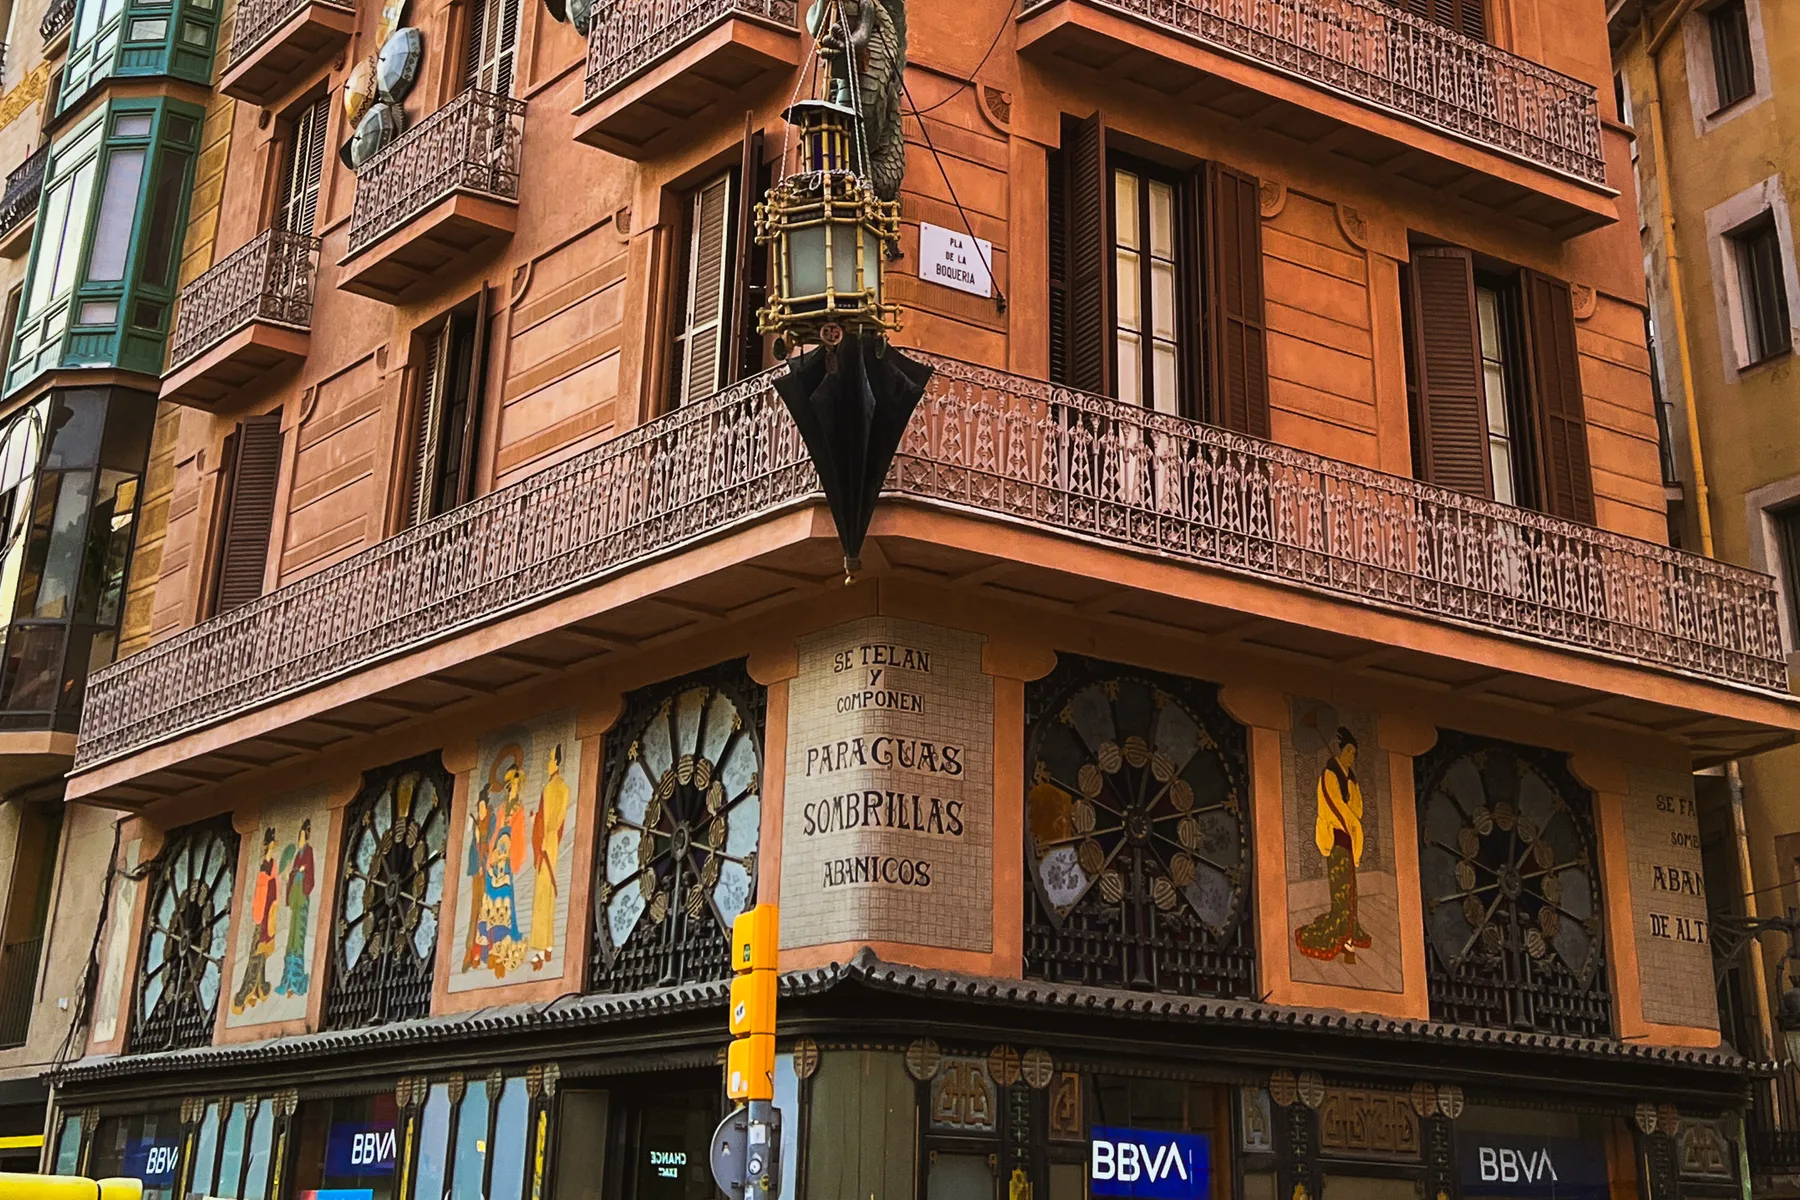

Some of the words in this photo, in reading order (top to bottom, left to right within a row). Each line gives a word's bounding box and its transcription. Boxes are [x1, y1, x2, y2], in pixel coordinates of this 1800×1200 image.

[946, 251, 954, 261] DE
[958, 255, 966, 265] LA
[950, 238, 963, 249] PLA
[937, 263, 975, 285] BOQUERIA
[833, 652, 853, 673] SE
[859, 645, 930, 672] TELAN
[869, 669, 881, 686] Y
[836, 690, 922, 713] COMPONEN
[806, 737, 964, 777] PARAGUAS
[803, 790, 964, 836] SOMBRILLAS
[1656, 794, 1675, 814] SE
[823, 856, 932, 888] ABANICOS
[1650, 913, 1671, 938] DE
[1676, 917, 1708, 944] ALT
[351, 1128, 397, 1165] BBVA
[1092, 1139, 1188, 1183] BBVA
[1478, 1147, 1558, 1183] BBVA
